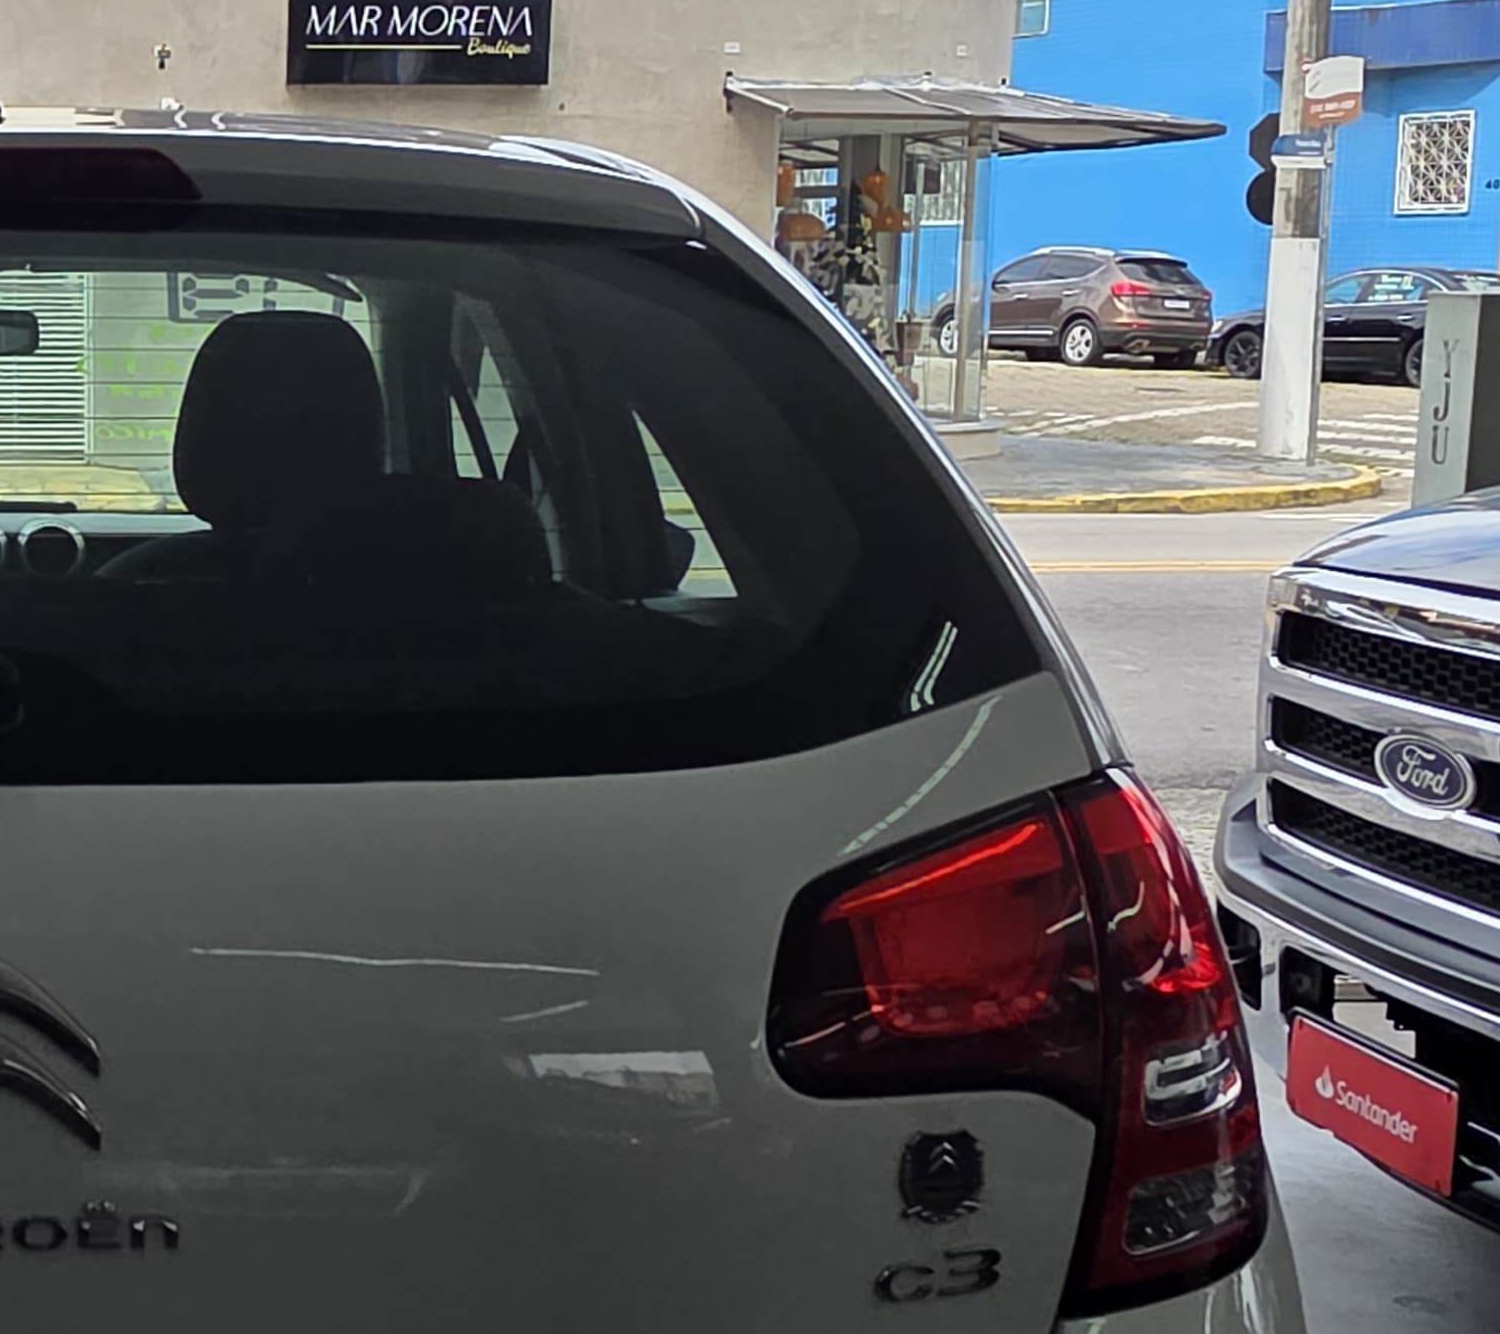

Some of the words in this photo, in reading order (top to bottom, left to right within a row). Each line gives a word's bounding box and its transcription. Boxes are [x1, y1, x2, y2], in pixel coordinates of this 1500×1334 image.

[306, 5, 382, 36] MAR
[387, 5, 533, 36] MORENA
[466, 36, 531, 59] Boutique
[1396, 745, 1450, 796] Ford
[1334, 1080, 1418, 1144] Santander
[873, 1248, 1002, 1302] C3
